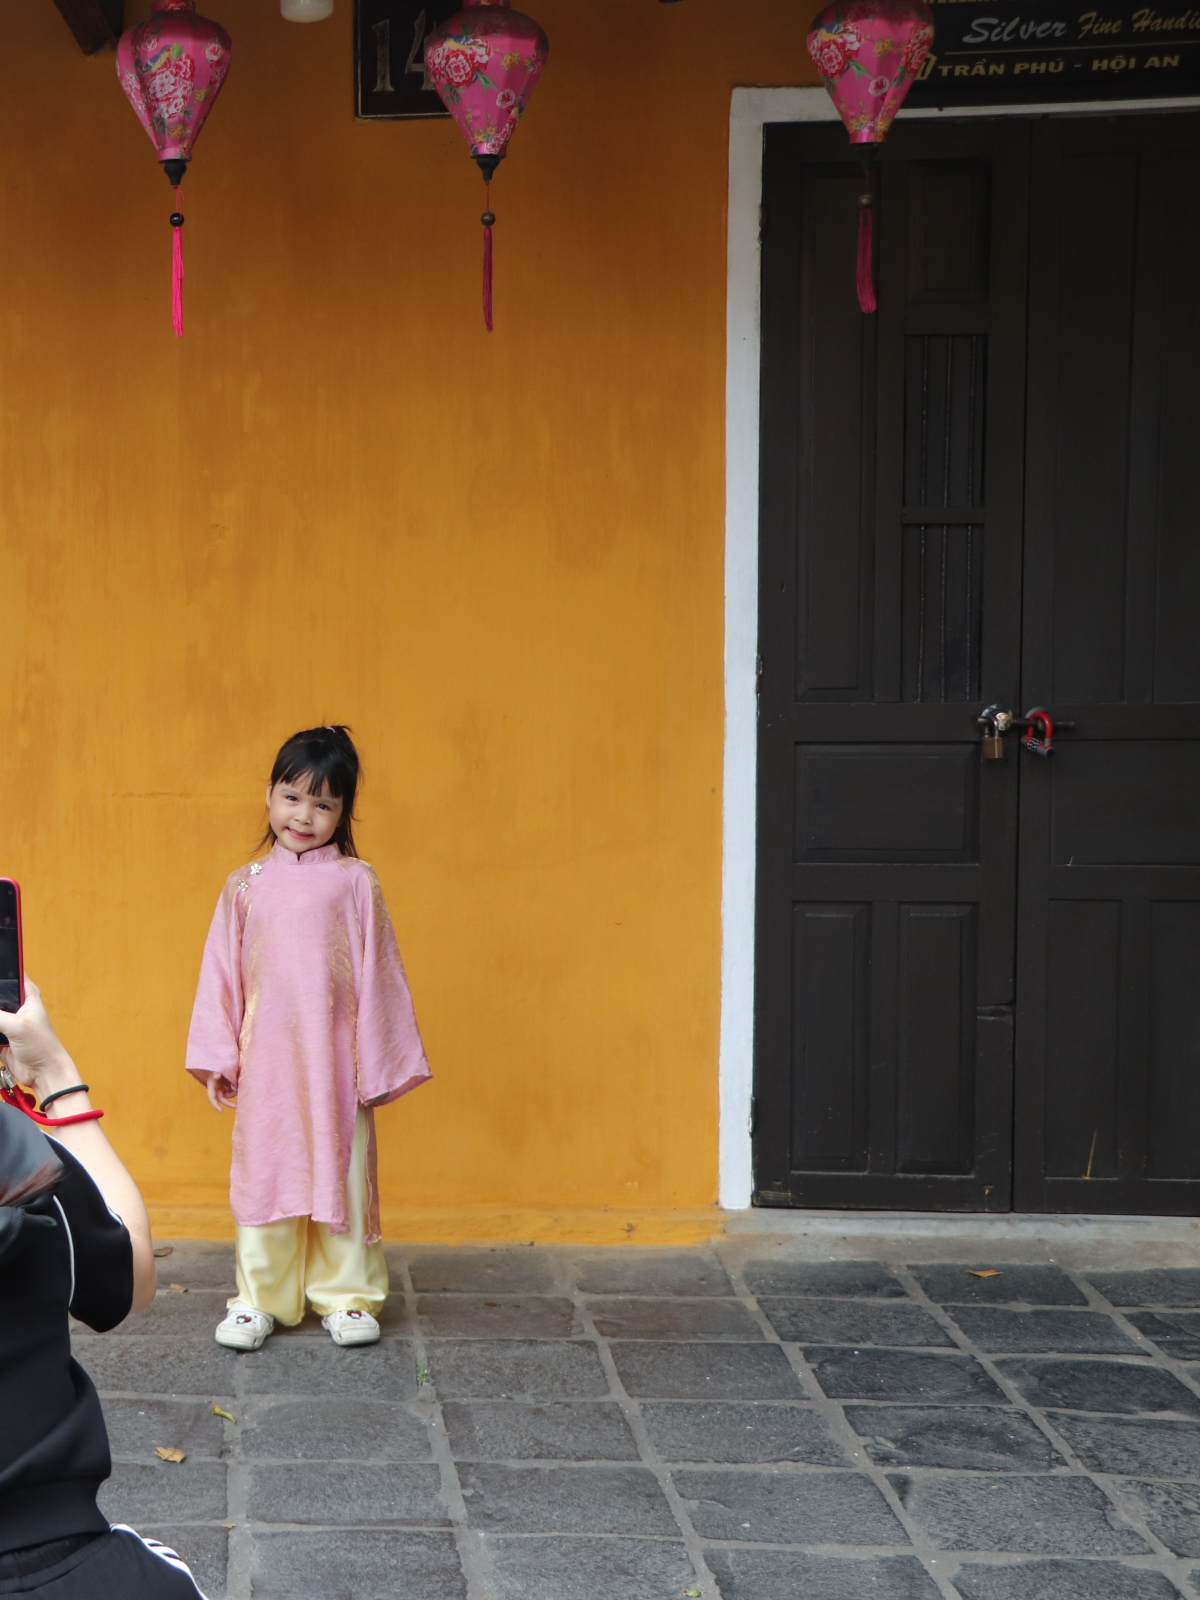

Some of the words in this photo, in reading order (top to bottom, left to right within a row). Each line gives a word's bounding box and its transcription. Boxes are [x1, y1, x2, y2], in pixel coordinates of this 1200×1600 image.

[961, 16, 1067, 44] Silver
[1077, 11, 1122, 40] Fine
[371, 9, 437, 92] 14
[937, 58, 1005, 77] TRẦN
[1013, 57, 1065, 75] PHÚ
[1090, 54, 1137, 73] HỘI
[1143, 54, 1181, 67] AN
